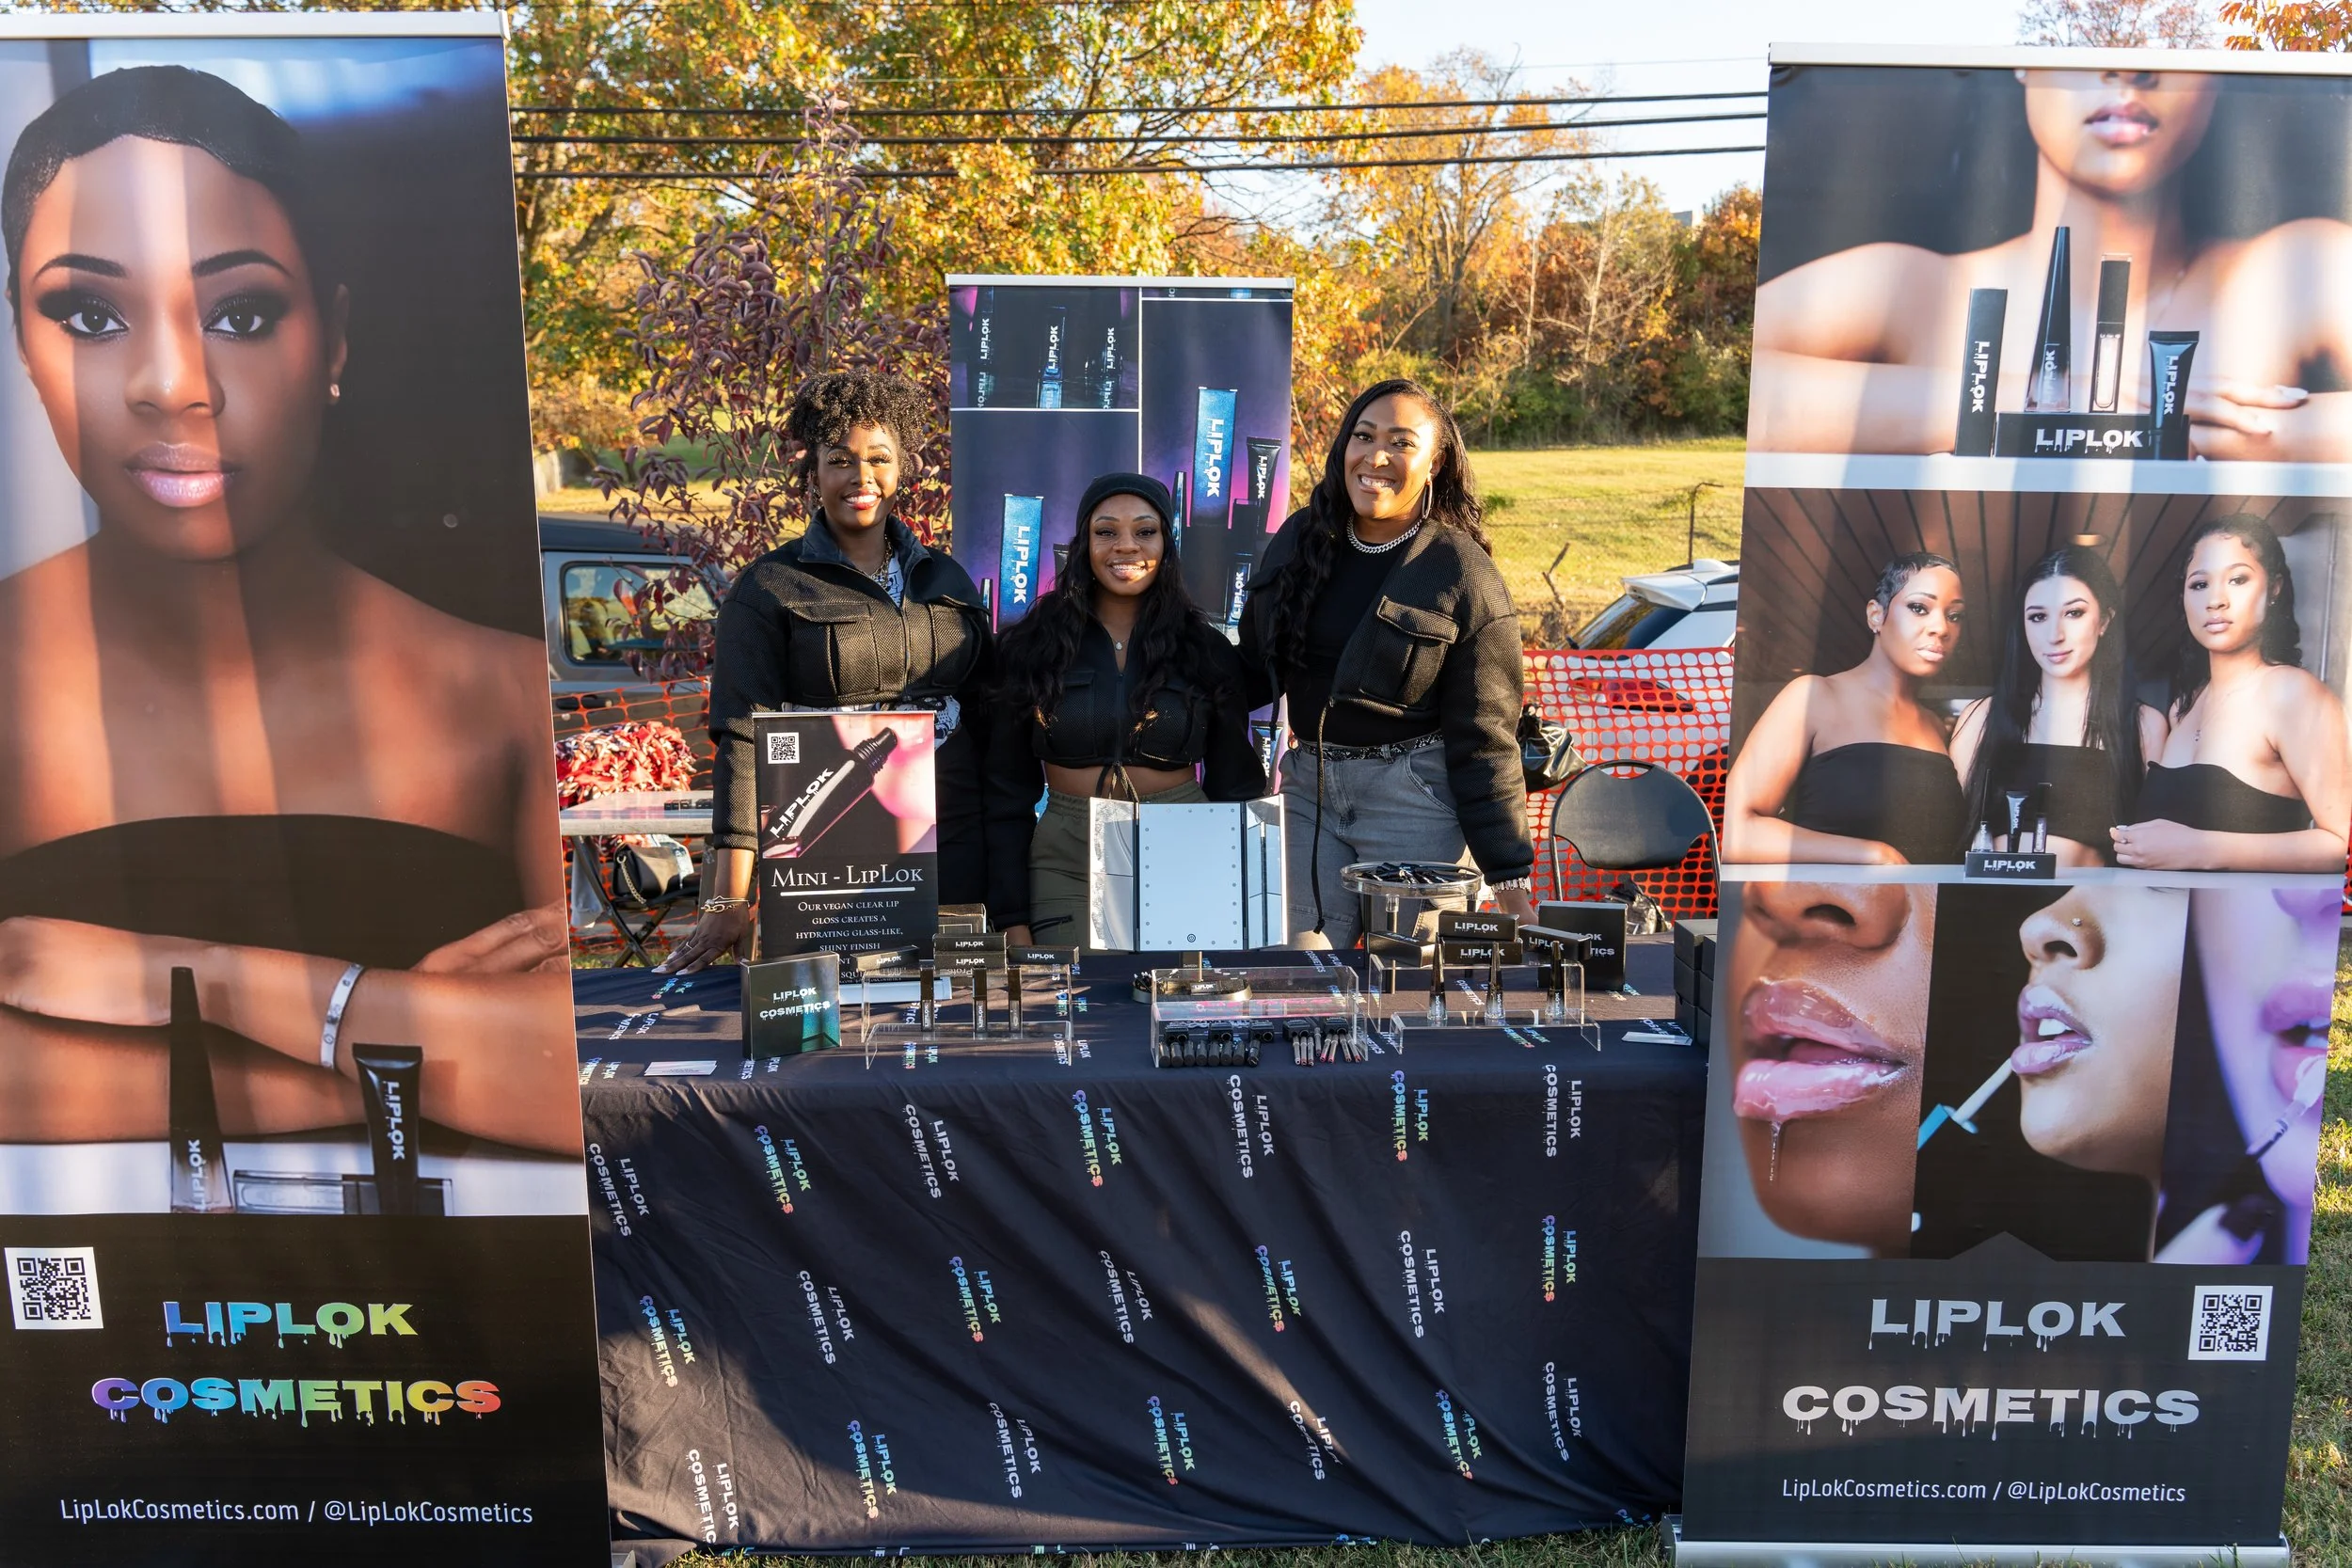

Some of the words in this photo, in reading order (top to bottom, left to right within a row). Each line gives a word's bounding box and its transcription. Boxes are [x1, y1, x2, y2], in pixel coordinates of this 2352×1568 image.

[980, 318, 991, 360] LIPLOK
[1048, 325, 1060, 370] LIPLOK
[1106, 327, 1117, 370] LIPLOK
[1970, 341, 1991, 414] LIPLOK
[2163, 355, 2179, 415] LIPLOK
[1204, 418, 1225, 498] LIPLOK
[2034, 428, 2144, 454] LIPLOK
[1257, 454, 1267, 499] LIPLOK
[1010, 525, 1031, 604] LIPLOK
[770, 768, 834, 838] LIPLOK
[1983, 859, 2037, 873] LIPLOK
[796, 929, 850, 940] HYDRATING
[812, 916, 839, 926] GLOSS
[841, 914, 879, 924] CREATES
[823, 901, 854, 911] VEGAN
[855, 900, 883, 909] CLEAR
[885, 899, 899, 908] LIP
[1454, 922, 1499, 933] LIPLOK
[819, 943, 848, 952] SHINY
[850, 942, 881, 951] FINISH
[759, 1001, 831, 1022] COSMETICS
[773, 986, 817, 1004] LIPLOK
[383, 1081, 405, 1161] LIPLOK
[1072, 1089, 1104, 1187] COSMETICS
[1097, 1106, 1122, 1165] LIPLOK
[1227, 1073, 1253, 1180] COSMETICS
[1253, 1094, 1274, 1157] LIPLOK
[1391, 1069, 1407, 1162] COSMETICS
[1413, 1088, 1428, 1142] LIPLOK
[1543, 1064, 1557, 1158] COSMETICS
[1567, 1080, 1581, 1139] LIPLOK
[755, 1124, 794, 1214] COSMETICS
[784, 1137, 811, 1192] LIPLOK
[904, 1103, 942, 1199] COSMETICS
[932, 1119, 960, 1182] LIPLOK
[589, 1142, 631, 1237] COSMETICS
[620, 1157, 649, 1216] LIPLOK
[1395, 1229, 1423, 1338] COSMETICS
[1422, 1248, 1445, 1315] LIPLOK
[1542, 1214, 1556, 1303] COSMETICS
[1564, 1230, 1576, 1284] LIPLOK
[797, 1270, 835, 1364] COSMETICS
[825, 1286, 854, 1341] LIPLOK
[948, 1257, 983, 1342] COSMETICS
[975, 1270, 1001, 1323] LIPLOK
[1098, 1250, 1132, 1344] COSMETICS
[1125, 1271, 1153, 1322] LIPLOK
[1255, 1244, 1285, 1333] COSMETICS
[1277, 1259, 1302, 1317] LIPLOK
[162, 1301, 419, 1349] LIPLOK
[640, 1294, 678, 1387] COSMETICS
[665, 1308, 696, 1364] LIPLOK
[1868, 1298, 2126, 1353] LIPLOK
[90, 1377, 502, 1428] COSMETICS
[1544, 1361, 1570, 1463] COSMETICS
[1565, 1378, 1582, 1439] LIPLOK
[1782, 1386, 2201, 1441] COSMETICS
[847, 1419, 879, 1520] COSMETICS
[872, 1433, 897, 1496] LIPLOK
[988, 1402, 1023, 1498] COSMETICS
[1014, 1418, 1041, 1474] LIPLOK
[1148, 1395, 1178, 1486] COSMETICS
[1170, 1412, 1195, 1471] LIPLOK
[60, 1498, 300, 1524] LipLokCosmetics.com
[324, 1499, 534, 1527] @LipLokCosmetics
[712, 1463, 739, 1530] LIPLOK
[1782, 1478, 1987, 1502] LipLokCosmetics.com
[2007, 1480, 2186, 1504] @LipLokCosmetics
